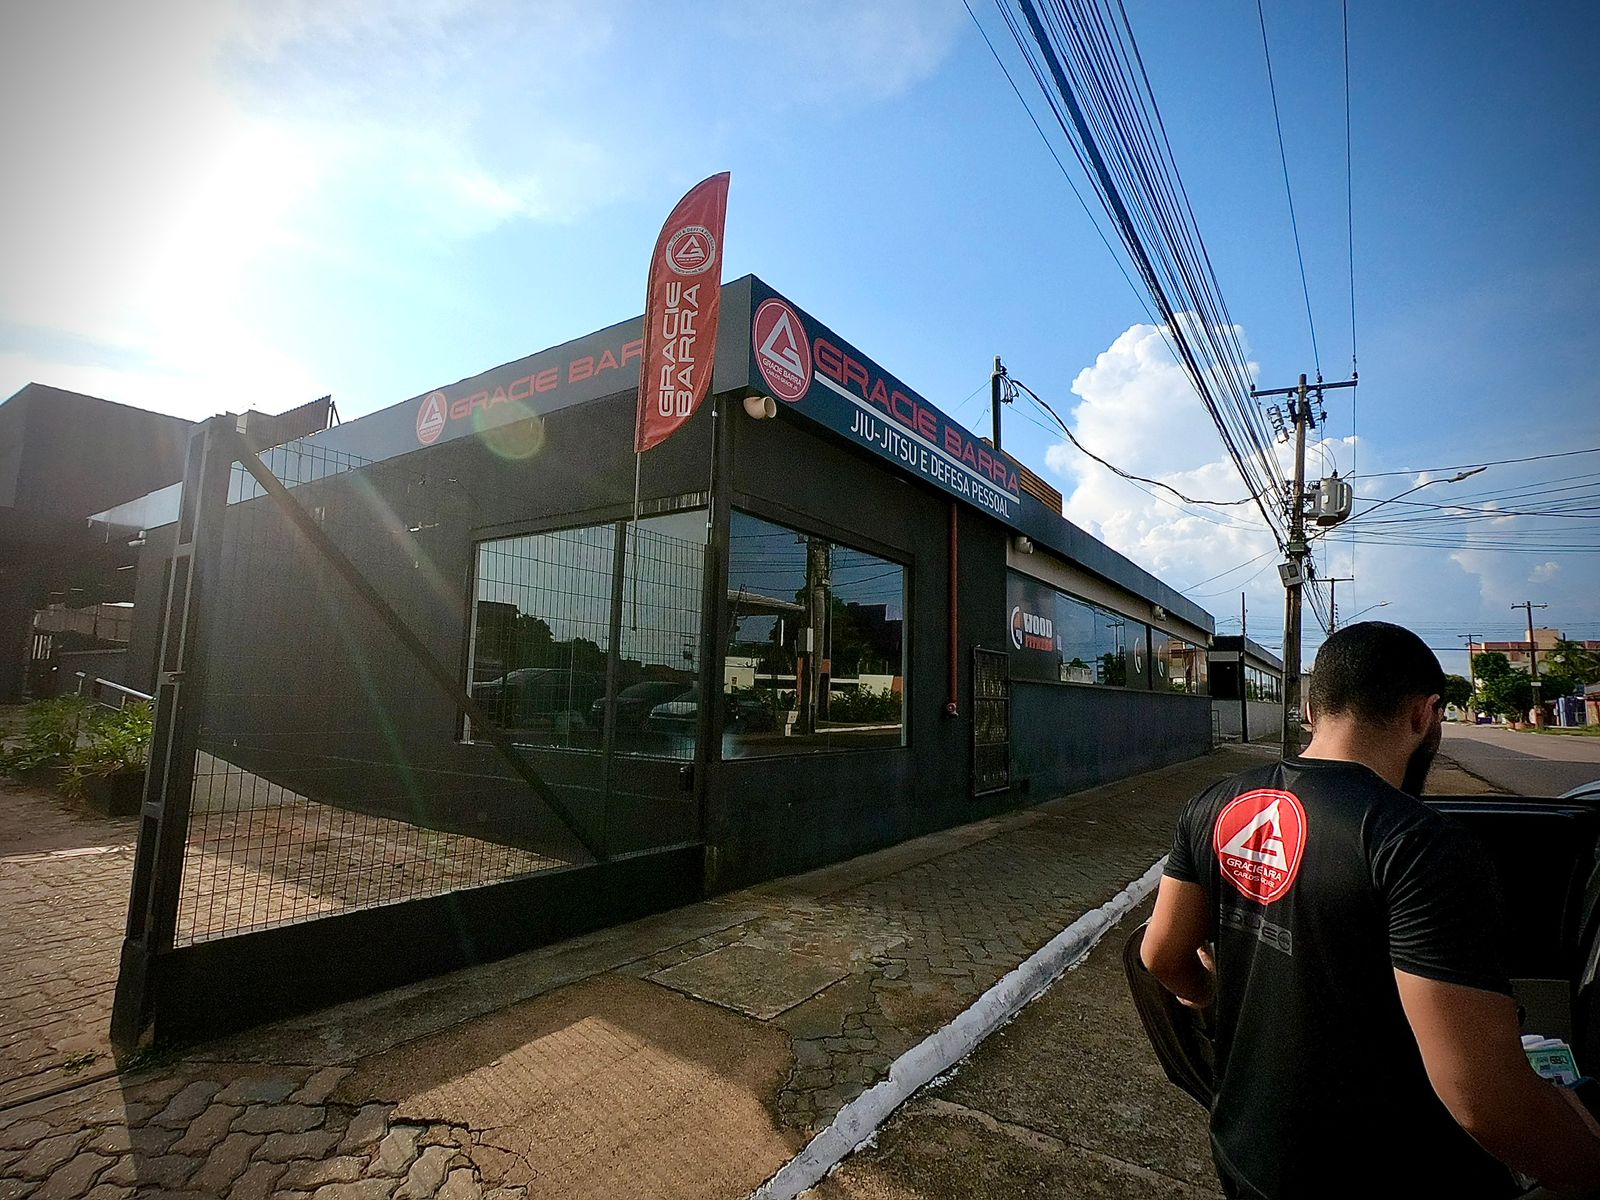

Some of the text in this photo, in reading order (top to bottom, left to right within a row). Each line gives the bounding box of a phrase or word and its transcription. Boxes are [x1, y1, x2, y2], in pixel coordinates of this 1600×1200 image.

[450, 338, 644, 420] GRACIE BAR
[659, 282, 681, 417] GRACIE
[676, 284, 700, 417] BARRA
[763, 357, 783, 375] GRACIE
[813, 337, 1019, 496] GRACIE BARRA
[850, 409, 1010, 519] JIU-JITSU E DEFESA PESSOAL
[1023, 612, 1053, 639] WOOD
[1226, 857, 1263, 875] GRACIE
[1233, 869, 1260, 882] CARLOS
